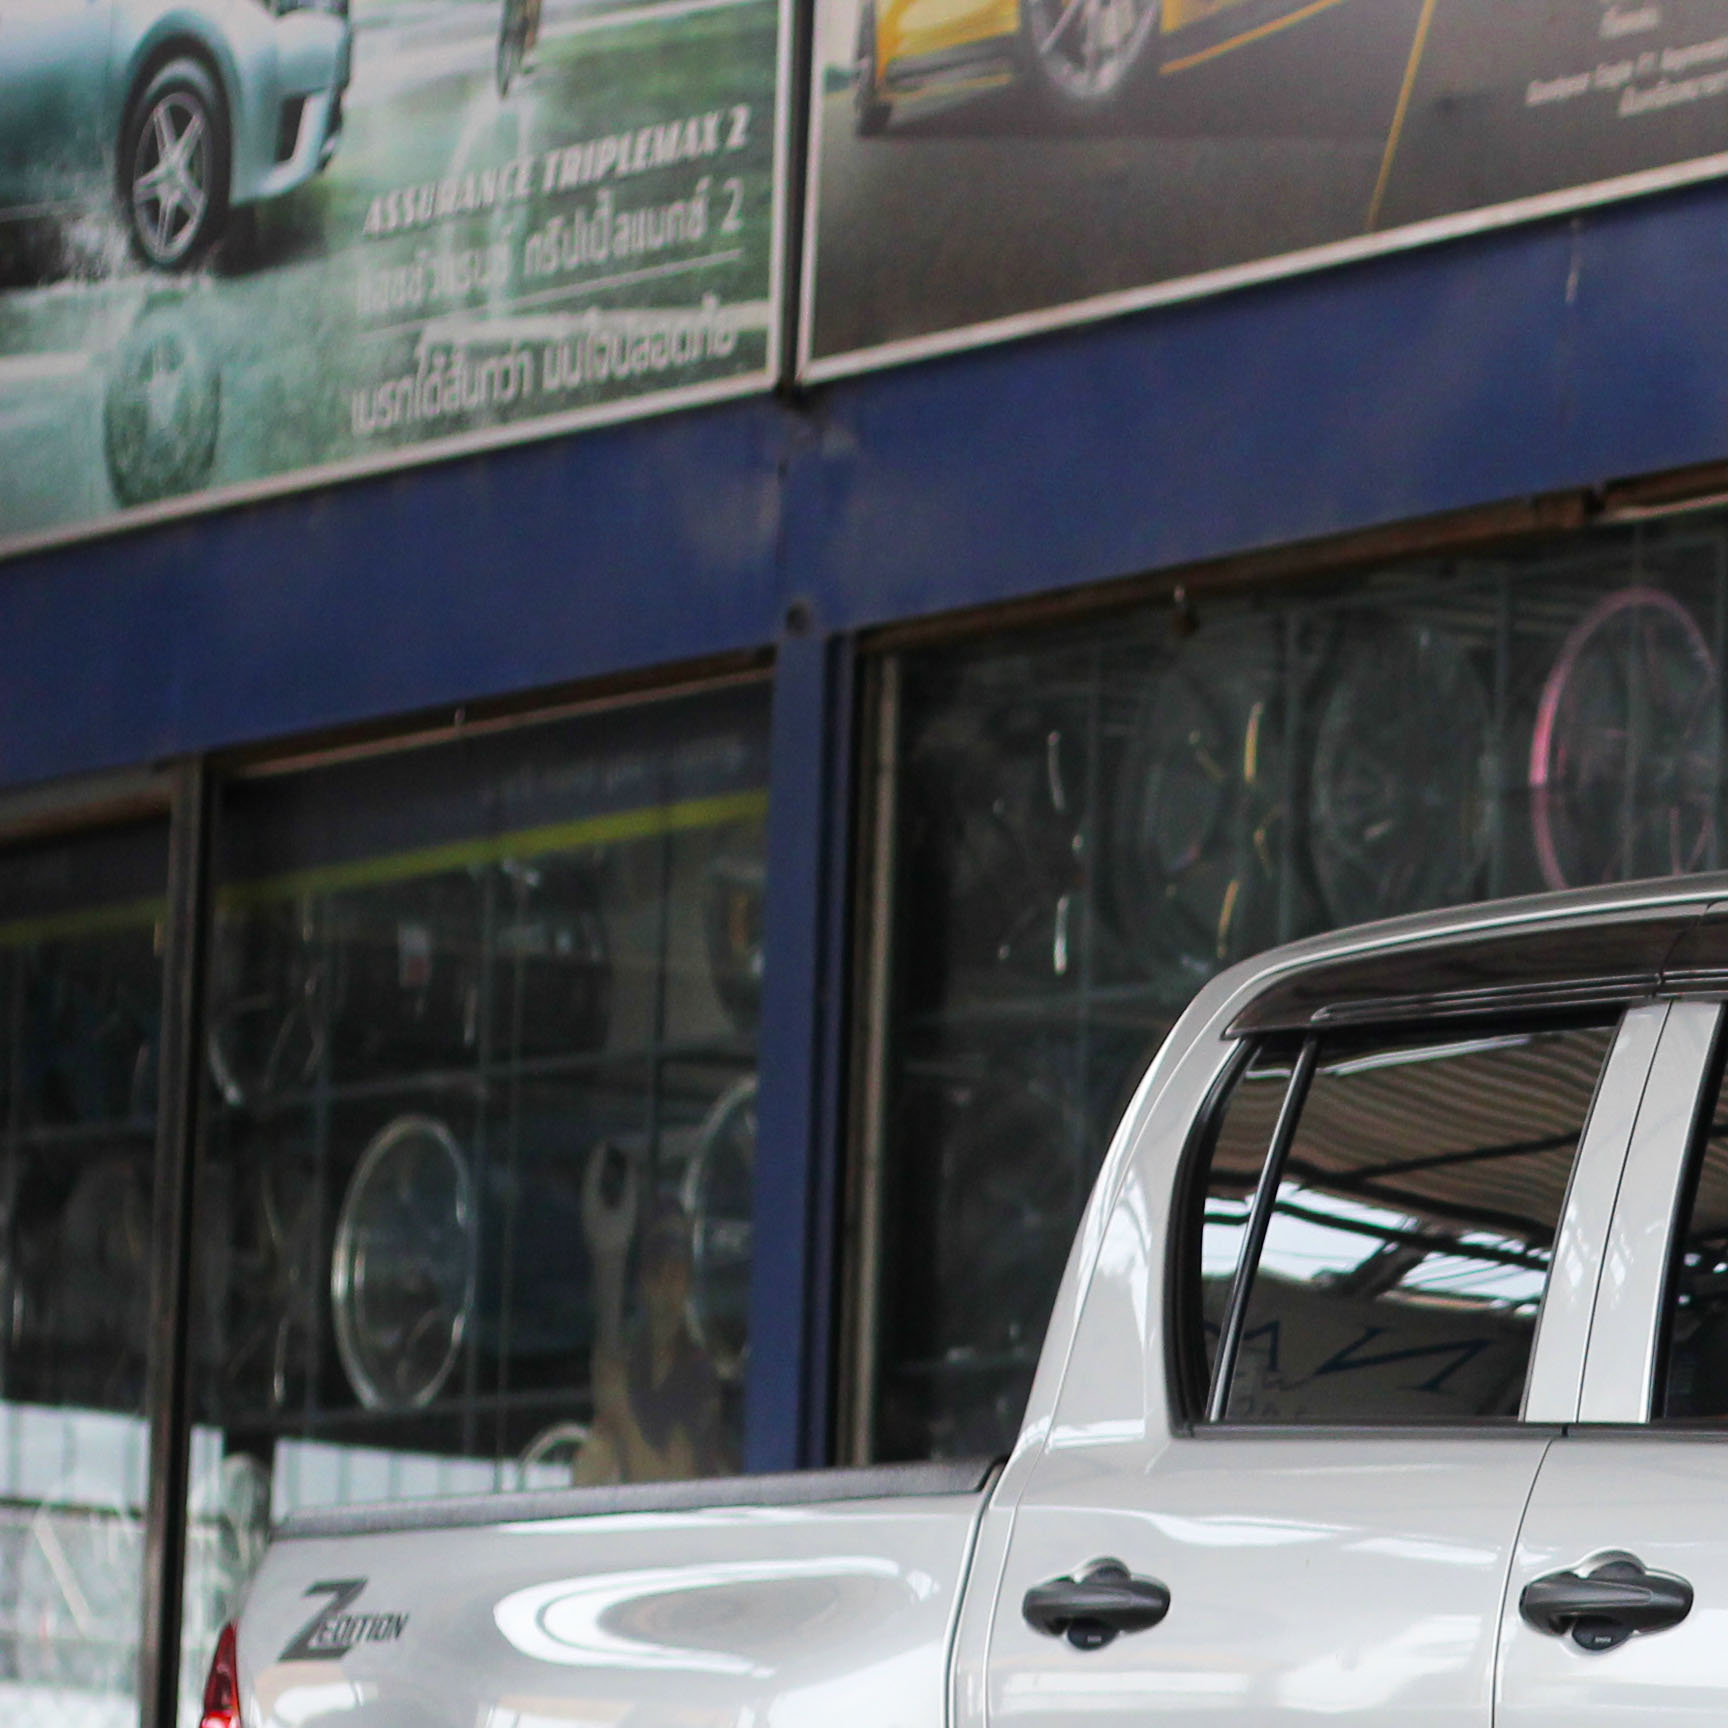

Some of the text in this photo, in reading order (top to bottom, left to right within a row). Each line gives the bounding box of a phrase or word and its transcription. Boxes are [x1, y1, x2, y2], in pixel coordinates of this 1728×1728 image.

[362, 103, 751, 237] ASSURANCE TRIPLEMAX 2
[720, 177, 745, 234] 2
[277, 1576, 369, 1662] Z
